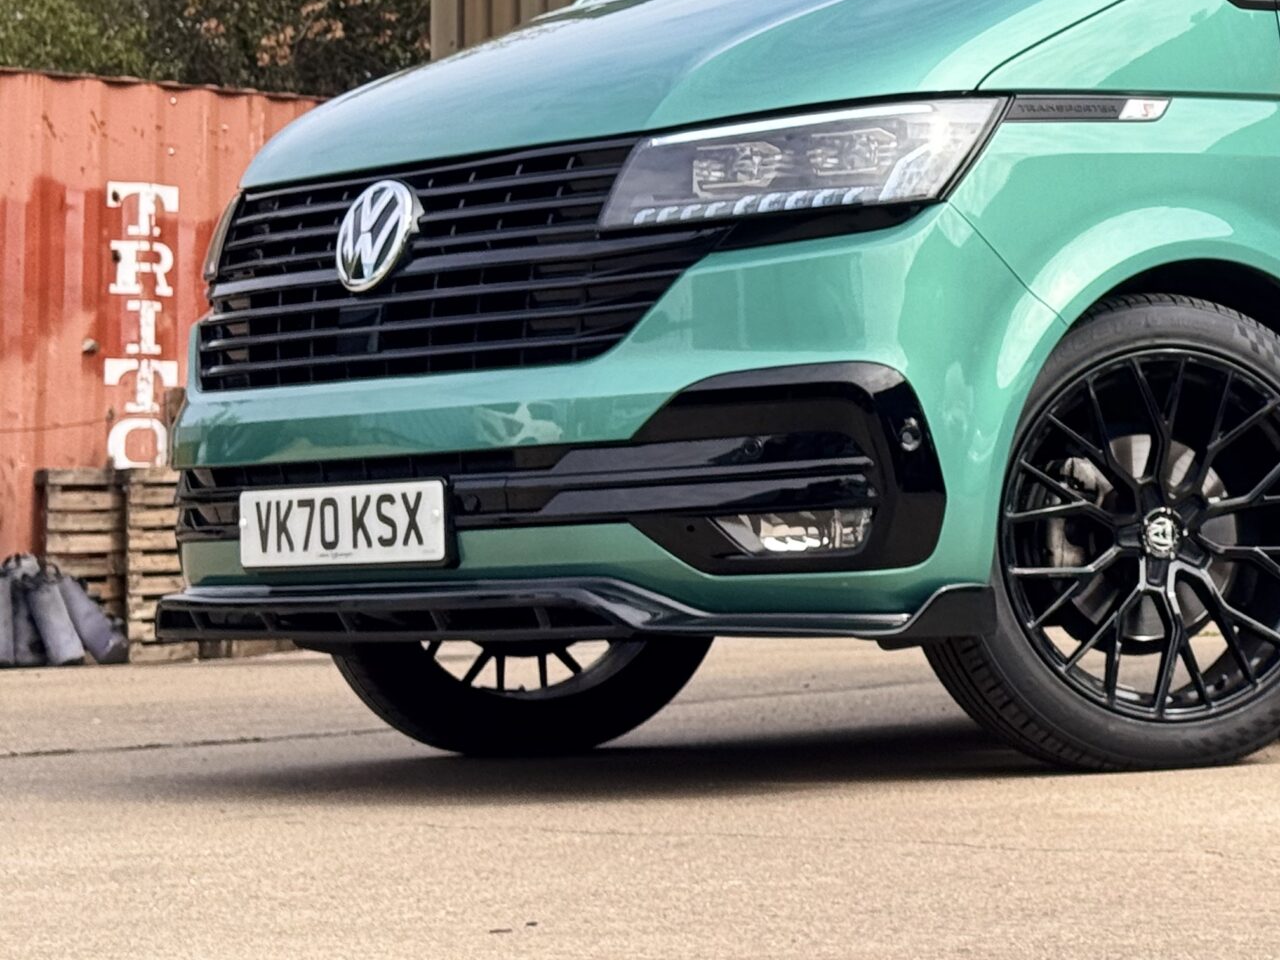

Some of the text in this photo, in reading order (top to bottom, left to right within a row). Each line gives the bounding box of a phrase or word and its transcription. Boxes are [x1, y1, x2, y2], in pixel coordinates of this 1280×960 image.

[1018, 104, 1118, 114] TRANSPORTER
[255, 491, 424, 554] VK70 KSX
